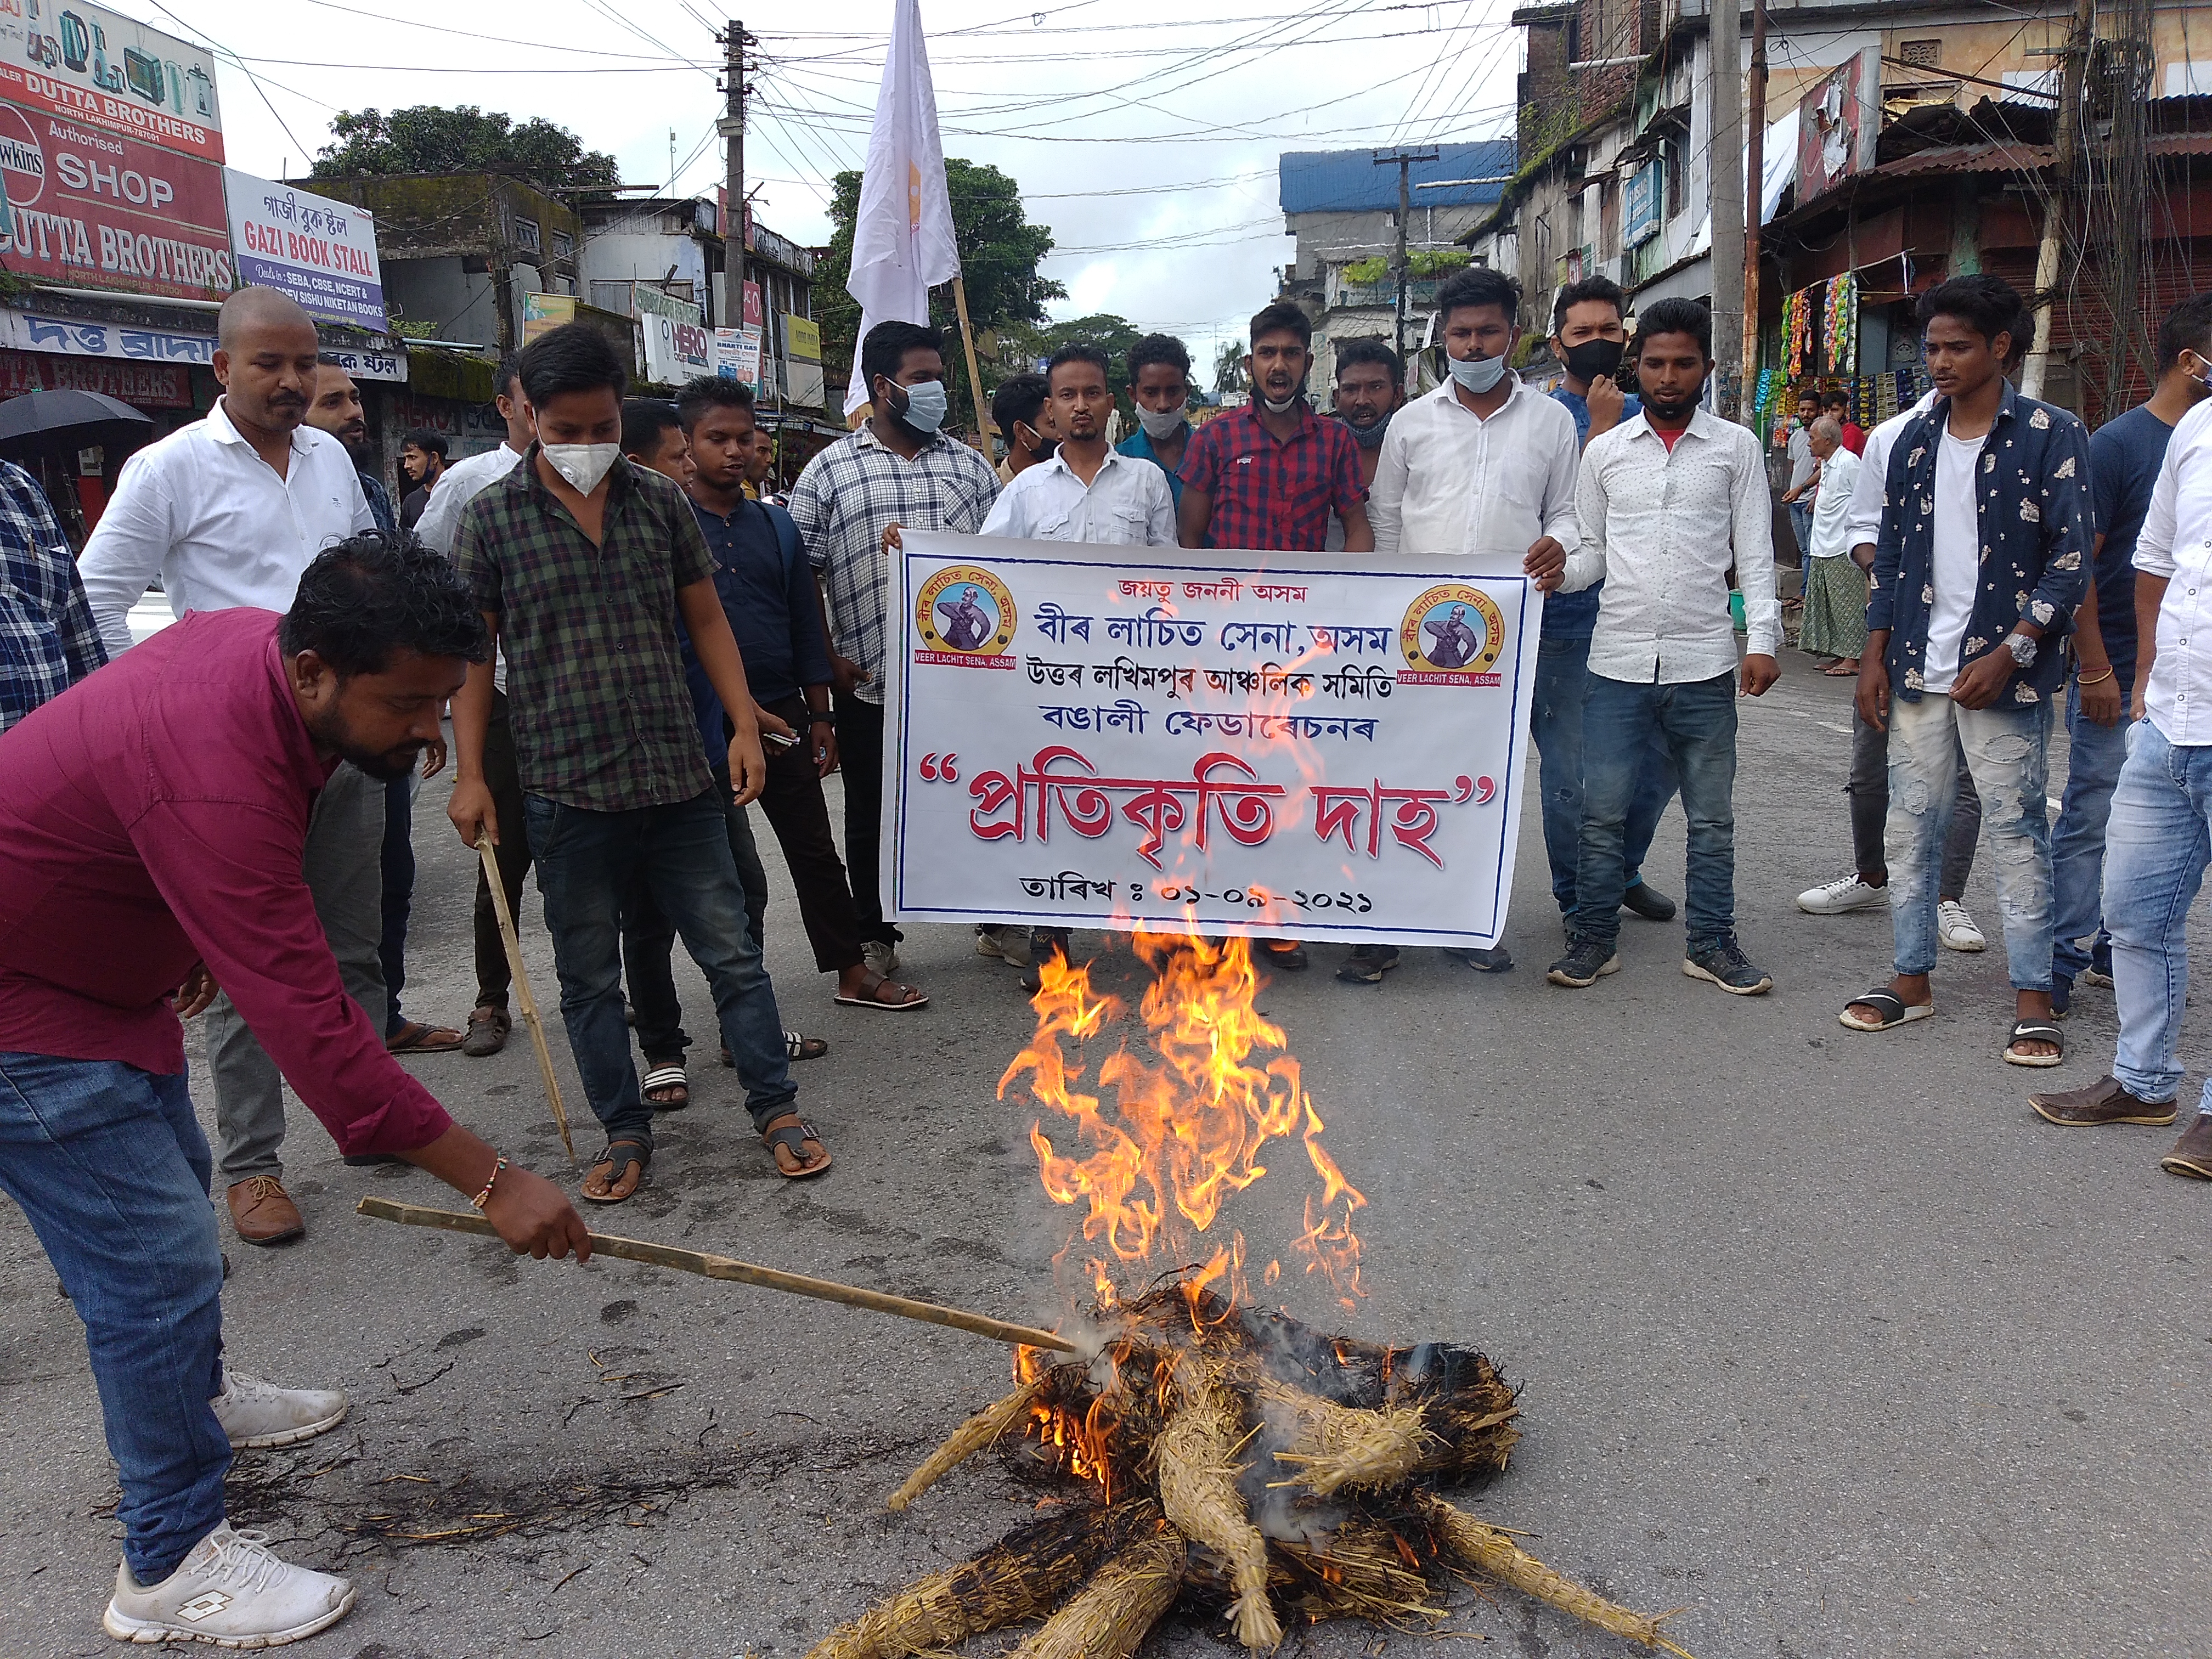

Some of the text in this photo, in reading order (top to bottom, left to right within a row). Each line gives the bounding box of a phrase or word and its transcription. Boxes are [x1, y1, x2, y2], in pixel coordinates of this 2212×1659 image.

[25, 72, 99, 112] DUTTA
[103, 98, 206, 145] BROTHERS
[55, 104, 84, 120] NORTH
[49, 120, 124, 156] Authorised
[56, 152, 174, 209] SHOP
[263, 191, 298, 228] গাজী
[298, 205, 323, 236] বুক
[0, 206, 234, 294] UTTA BROTHERS
[244, 221, 373, 277] GAZI BOOK STALL
[67, 268, 98, 283] NORTH
[286, 271, 311, 291] SEBA,
[312, 278, 335, 295] CBSE,
[335, 282, 362, 300] NCERT
[362, 287, 368, 300] &
[299, 291, 324, 307] SISHU
[323, 296, 358, 314] NIKETAN
[358, 302, 383, 318] BOOKS
[671, 321, 708, 359] HERO
[926, 571, 962, 596] লাচিত
[1000, 595, 1012, 629] অসম
[1182, 577, 1244, 602] জননী
[1251, 584, 1308, 603] অসম
[1033, 602, 1094, 645] বীৰ
[1104, 606, 1207, 648] লাচিত
[1413, 589, 1451, 615] লাচিত
[1488, 612, 1501, 646] অসম
[915, 652, 935, 662] VEER
[936, 653, 964, 665] LACHIT
[990, 657, 1017, 668] ASSAM
[1026, 654, 1085, 689] উত্তৰ
[1092, 656, 1196, 699] লখিমপুৰ
[1323, 664, 1397, 701] সমিতি
[1397, 673, 1501, 685] VEER LACHIT SENA, ASSAM
[1037, 698, 1150, 735] বঙালী
[1018, 870, 1117, 901] তাৰিখ
